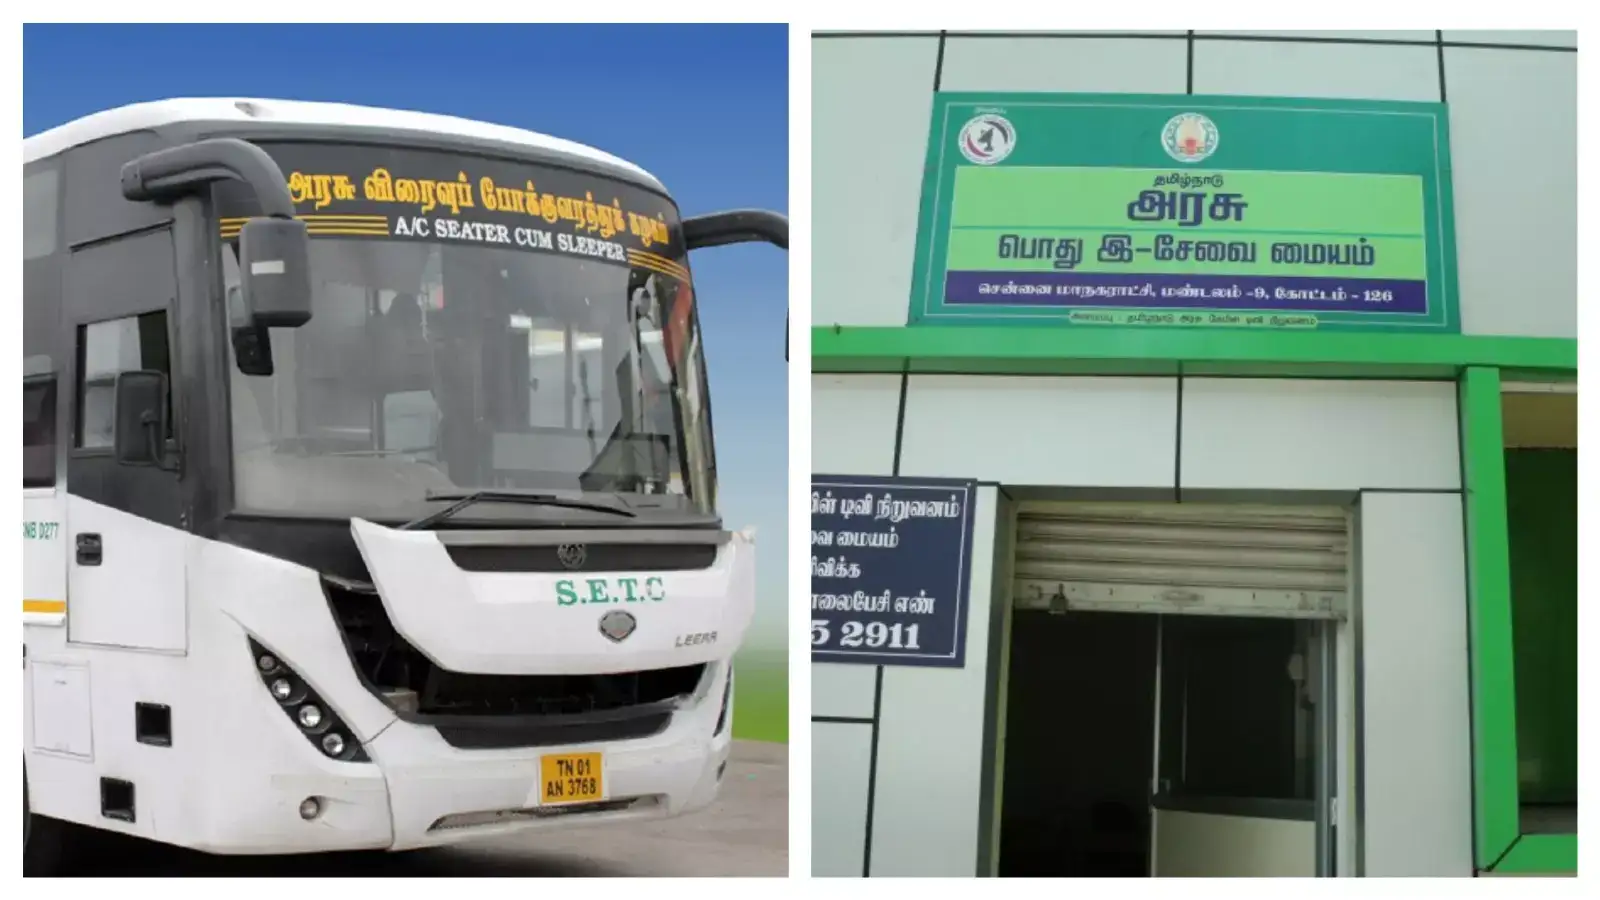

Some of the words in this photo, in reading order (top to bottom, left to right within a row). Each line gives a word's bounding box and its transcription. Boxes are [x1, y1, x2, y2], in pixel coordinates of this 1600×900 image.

[1153, 173, 1224, 189] தமிழ்நாடு
[288, 171, 356, 211] அரசு
[364, 168, 475, 215] விரைவுப்
[480, 176, 626, 239] போக்குவரத்துக்
[1127, 189, 1248, 227] அரசு
[395, 216, 430, 237] A/C
[434, 218, 511, 244] SEATER
[514, 227, 553, 250] CUM
[557, 233, 627, 261] SLEEPER
[998, 233, 1083, 269] பொது
[1097, 234, 1256, 263] இ-சேவை
[1271, 238, 1375, 266] மையம்
[978, 281, 1051, 295] சென்னை
[1056, 283, 1155, 299] மாநகராட்சி,
[1161, 283, 1242, 298] மண்டலம்
[1274, 286, 1347, 301] கோட்டம்
[1364, 290, 1393, 301] 126
[840, 493, 873, 519] டிவி
[874, 493, 960, 523] நிறுவனம்
[23, 521, 37, 539] NB
[39, 521, 60, 540] D277
[837, 526, 899, 548] மையம்
[556, 577, 665, 606] S.E.T.C
[894, 589, 936, 614] எண்
[811, 619, 831, 645] 5
[840, 621, 920, 649] 2911
[557, 759, 575, 776] TN
[577, 758, 591, 776] 01
[547, 780, 564, 797] AN
[567, 777, 597, 797] 3768
